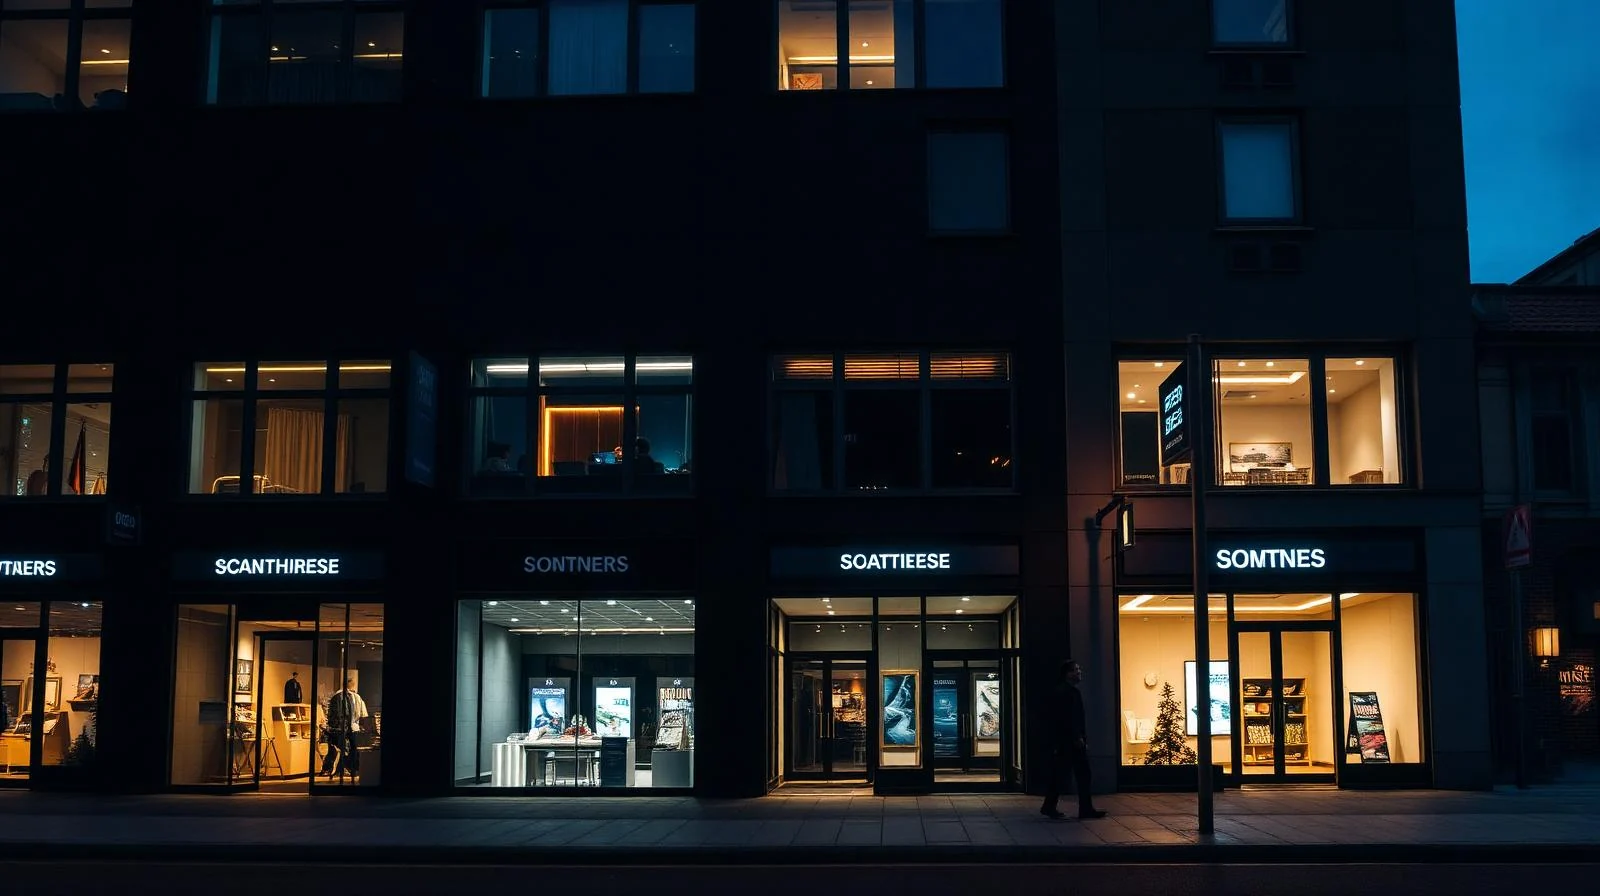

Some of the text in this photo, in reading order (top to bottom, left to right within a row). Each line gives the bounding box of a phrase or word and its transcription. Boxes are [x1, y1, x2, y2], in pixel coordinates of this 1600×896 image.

[215, 558, 340, 575] SCANTHIRESE
[524, 555, 629, 573] SONTNERS
[840, 553, 951, 570] SOATTIEESE
[1216, 548, 1326, 569] SOMTNES
